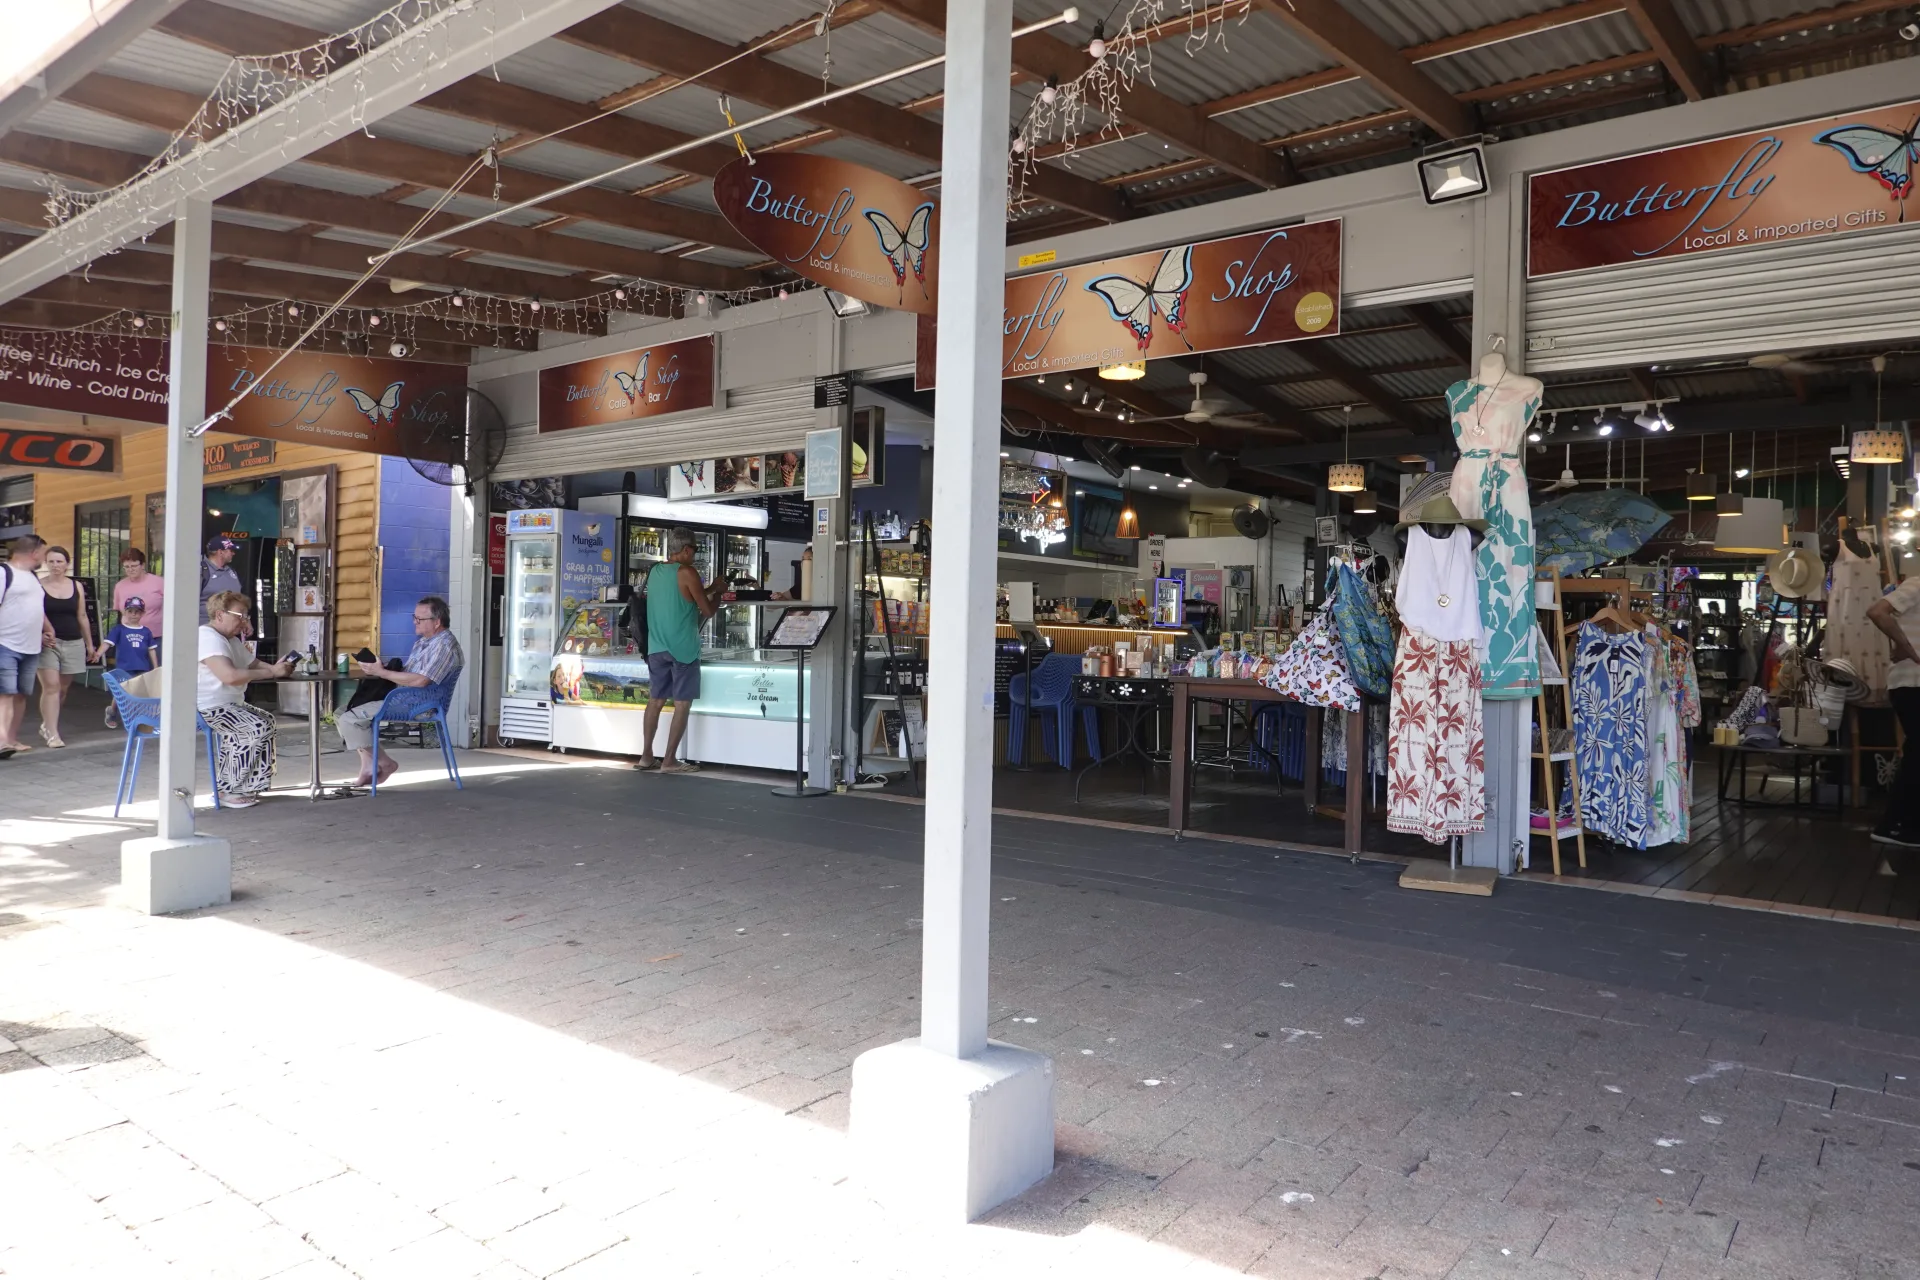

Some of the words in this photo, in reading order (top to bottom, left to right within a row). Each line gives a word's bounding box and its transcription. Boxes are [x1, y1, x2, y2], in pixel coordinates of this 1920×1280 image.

[1556, 136, 1783, 256] Butterfly
[746, 176, 855, 262] Butterfly
[1684, 230, 1731, 249] Local
[1736, 229, 1749, 242] &
[1754, 213, 1838, 239] imported
[1844, 208, 1886, 226] Gifts
[810, 256, 832, 271] Local
[833, 263, 840, 273] &
[841, 265, 876, 282] imported
[1002, 272, 1069, 371] erfly
[1212, 231, 1298, 336] Shop
[1296, 304, 1332, 314] Established
[1306, 317, 1322, 325] 2009
[0, 343, 32, 361] ffee
[50, 352, 101, 373] Lunch
[116, 364, 142, 379] Ice
[146, 368, 171, 384] Cre
[1013, 358, 1039, 372] Local
[1042, 357, 1050, 368] &
[1052, 351, 1098, 367] imported
[1102, 347, 1124, 360] Gifts
[28, 371, 72, 390] Wine
[88, 381, 129, 399] Cold
[132, 387, 170, 404] Drink
[567, 368, 610, 418] Butterfly
[653, 354, 680, 400] Shop
[229, 368, 339, 427] Butterfly
[402, 391, 448, 444] Shop
[648, 392, 661, 403] Bar
[296, 423, 315, 432] Local
[354, 432, 369, 440] Gifts
[0, 432, 105, 467] CO
[205, 445, 225, 466] ICO
[572, 534, 604, 548] Mungalli
[1149, 539, 1164, 547] ORDER
[1150, 549, 1161, 557] HERE
[563, 573, 572, 581] OF
[566, 562, 586, 573] GRAB
[586, 564, 593, 573] A
[594, 563, 610, 574] TUB
[1695, 589, 1742, 598] WoodWick
[747, 692, 758, 701] Ice
[759, 694, 779, 702] Cream
